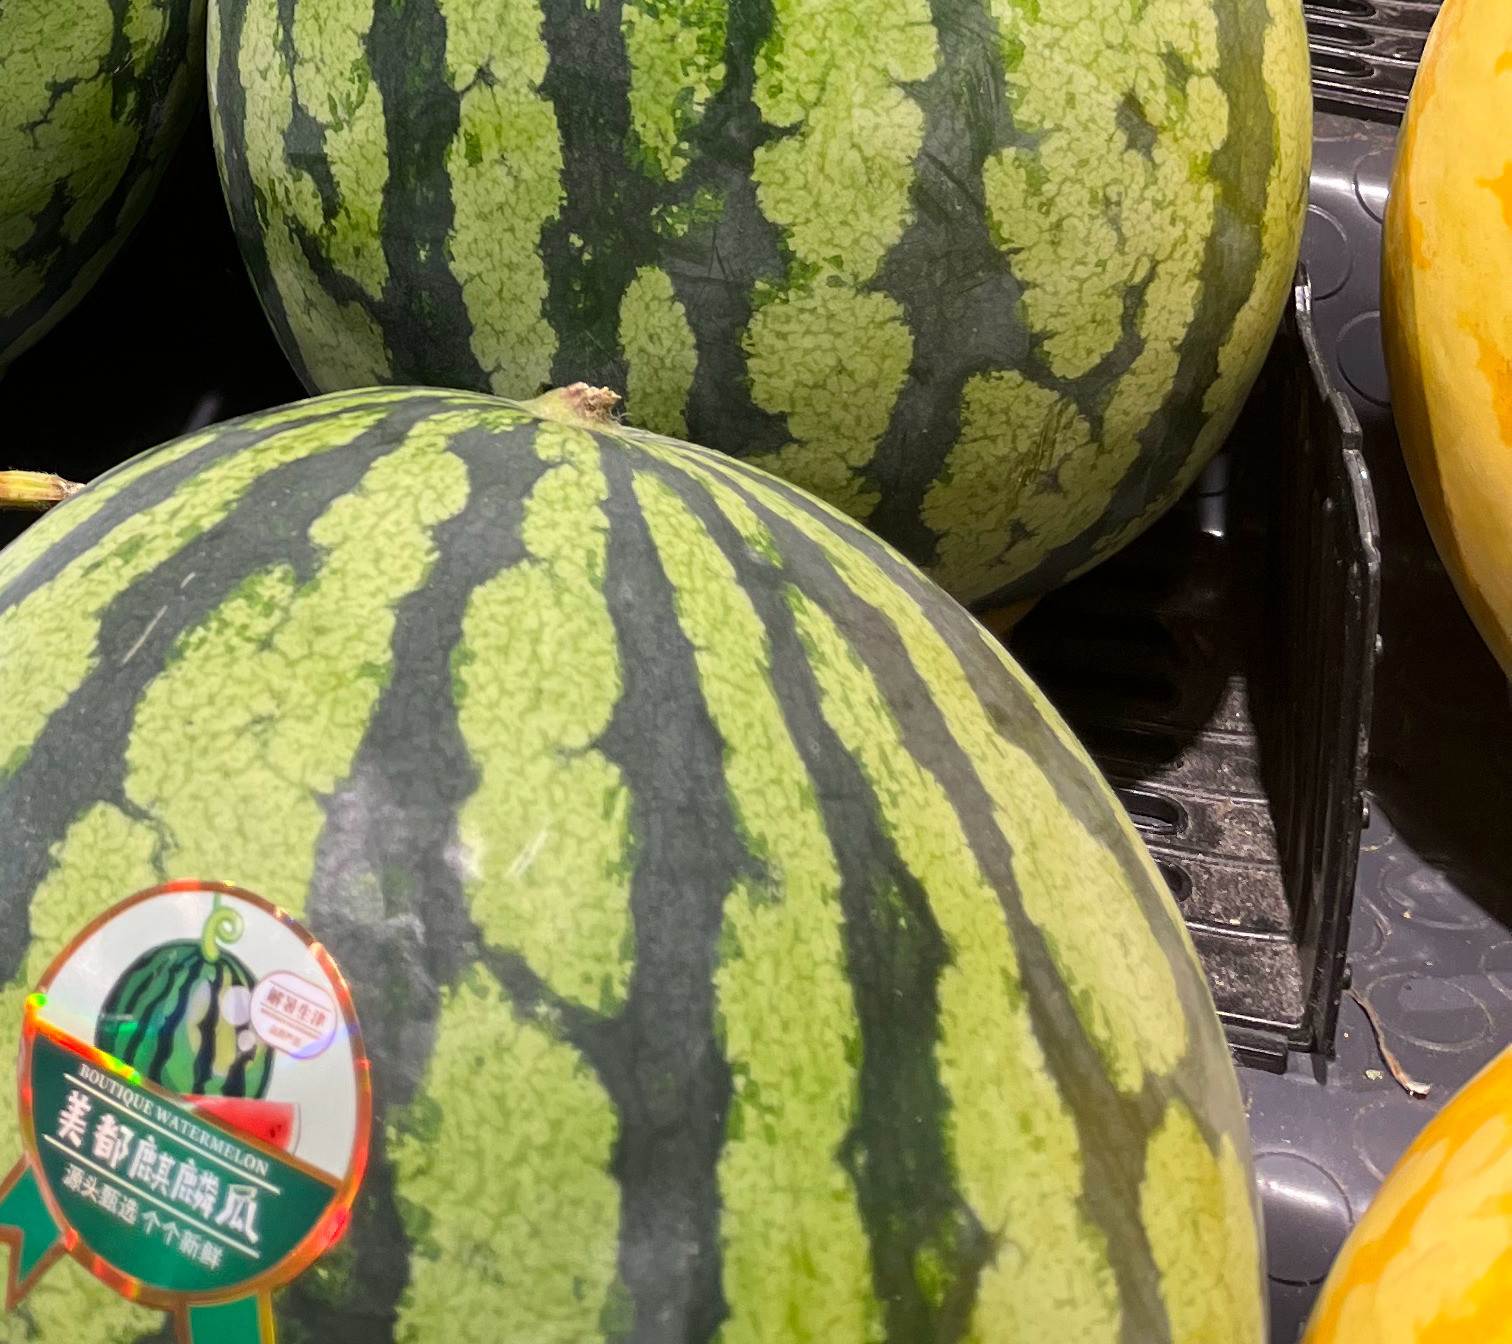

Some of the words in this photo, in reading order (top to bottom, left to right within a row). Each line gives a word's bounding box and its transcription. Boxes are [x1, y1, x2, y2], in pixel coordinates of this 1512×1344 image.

[57, 1090, 259, 1244] 美都麒麟瓜
[79, 1064, 153, 1116] BOUTIQUE
[156, 1105, 269, 1176] WATERMELON
[63, 1163, 137, 1224] 源头甄选
[142, 1211, 223, 1270] 个个新鲜
